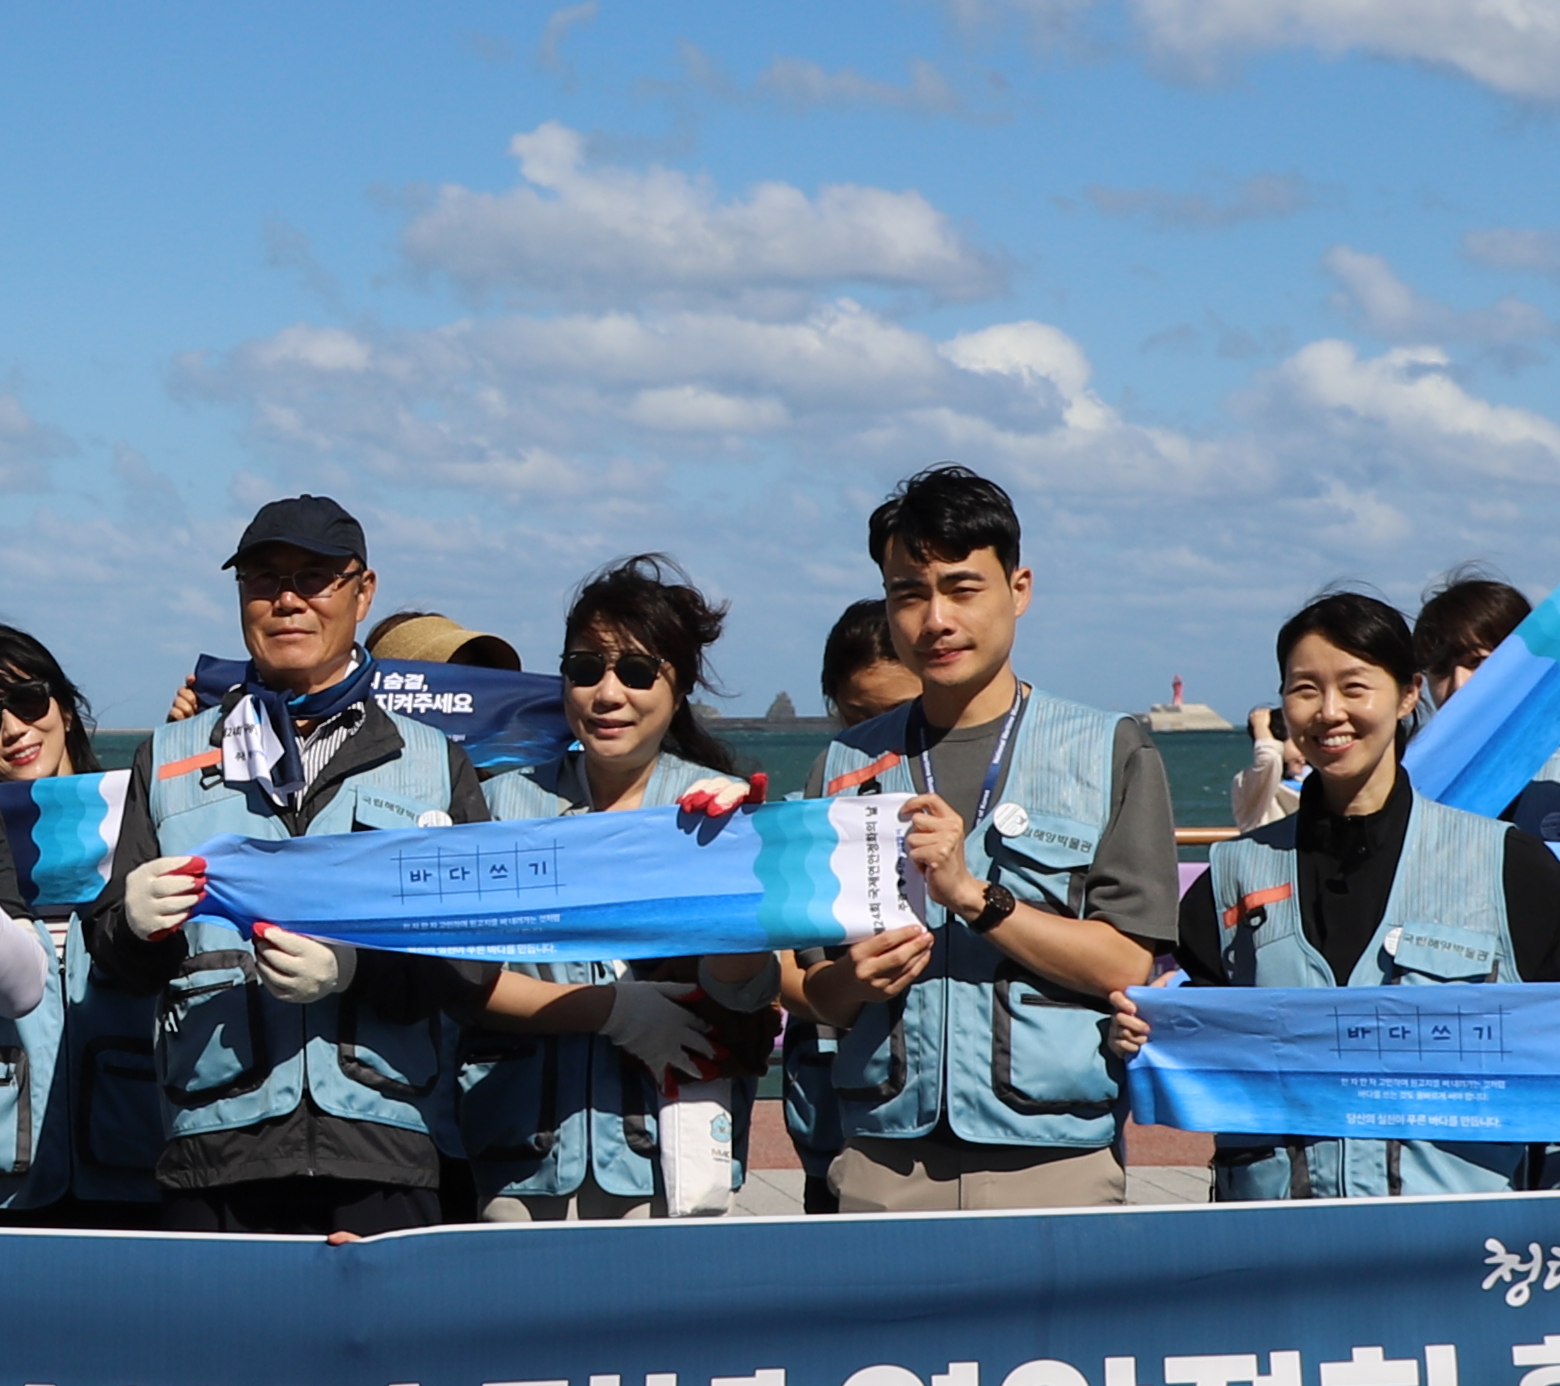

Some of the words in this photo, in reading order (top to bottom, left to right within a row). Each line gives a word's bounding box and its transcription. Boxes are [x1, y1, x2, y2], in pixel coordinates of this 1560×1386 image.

[383, 672, 429, 693] 숨결,
[362, 795, 419, 823] 국립해양박
[865, 805, 878, 817] 날
[1021, 827, 1093, 854] 립해양박물관
[866, 822, 879, 898] 국제연안정화의
[1403, 933, 1489, 962] 국립해양박물관
